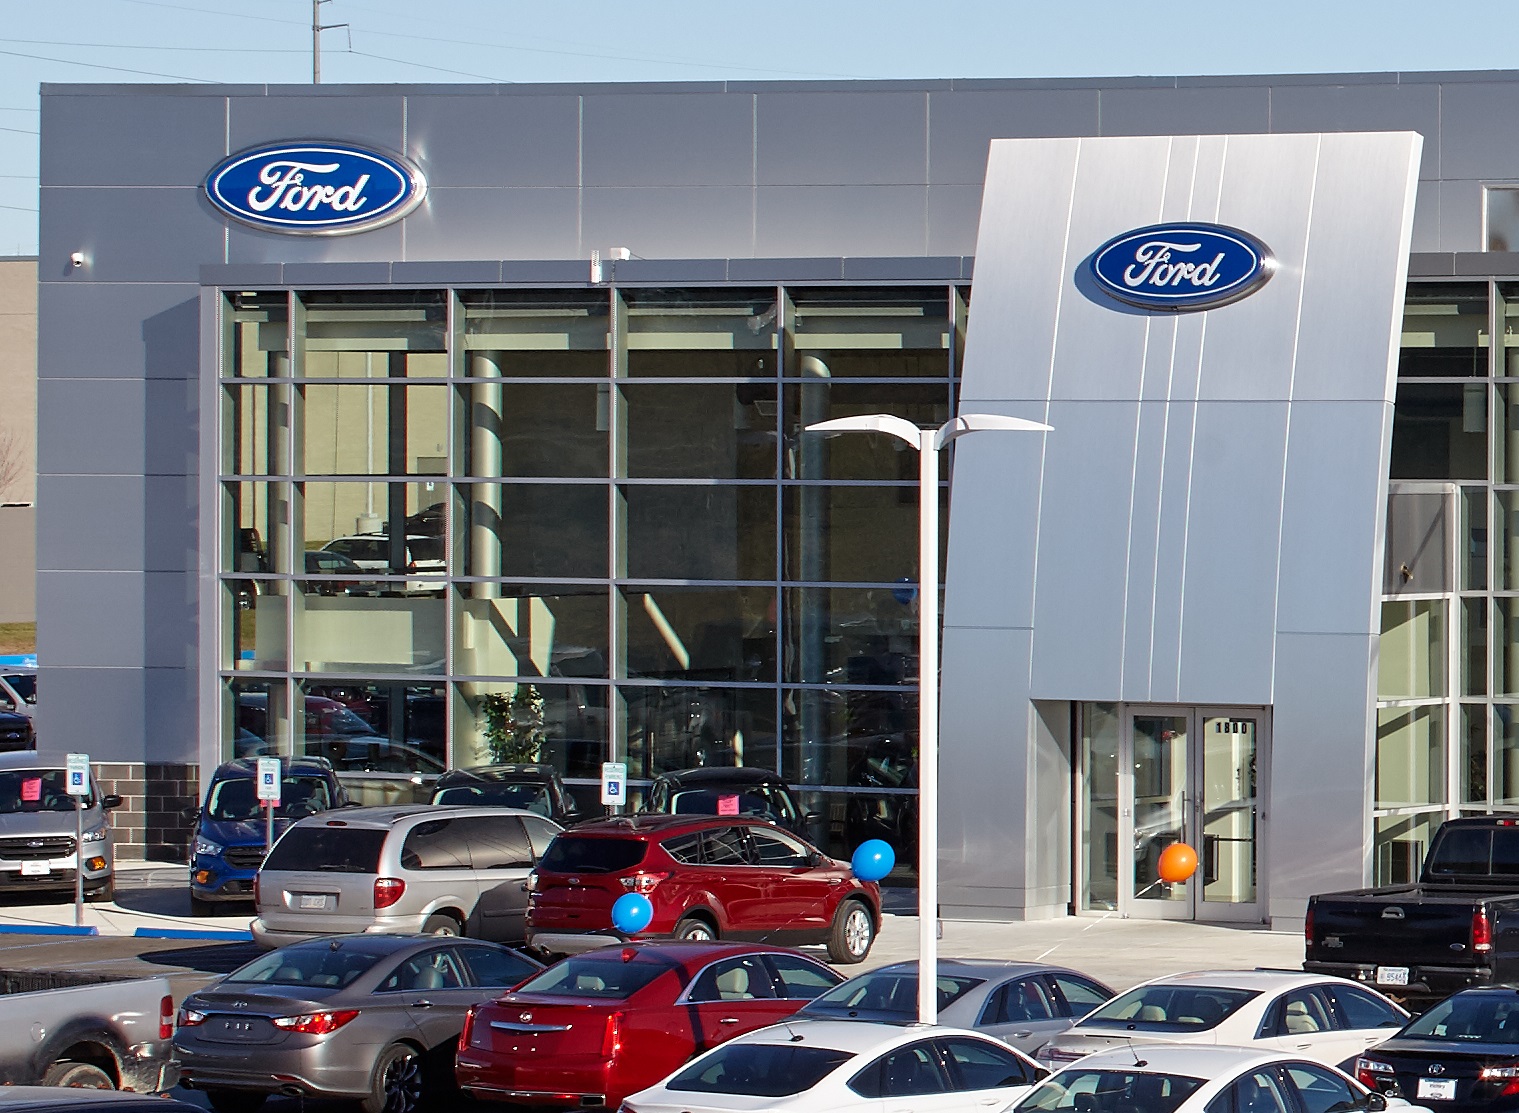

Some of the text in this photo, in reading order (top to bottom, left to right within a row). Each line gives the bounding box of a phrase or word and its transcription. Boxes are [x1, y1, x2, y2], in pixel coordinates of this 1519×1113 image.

[248, 160, 371, 211] Ford
[1124, 241, 1226, 287] Ford
[1216, 722, 1247, 734] 1800
